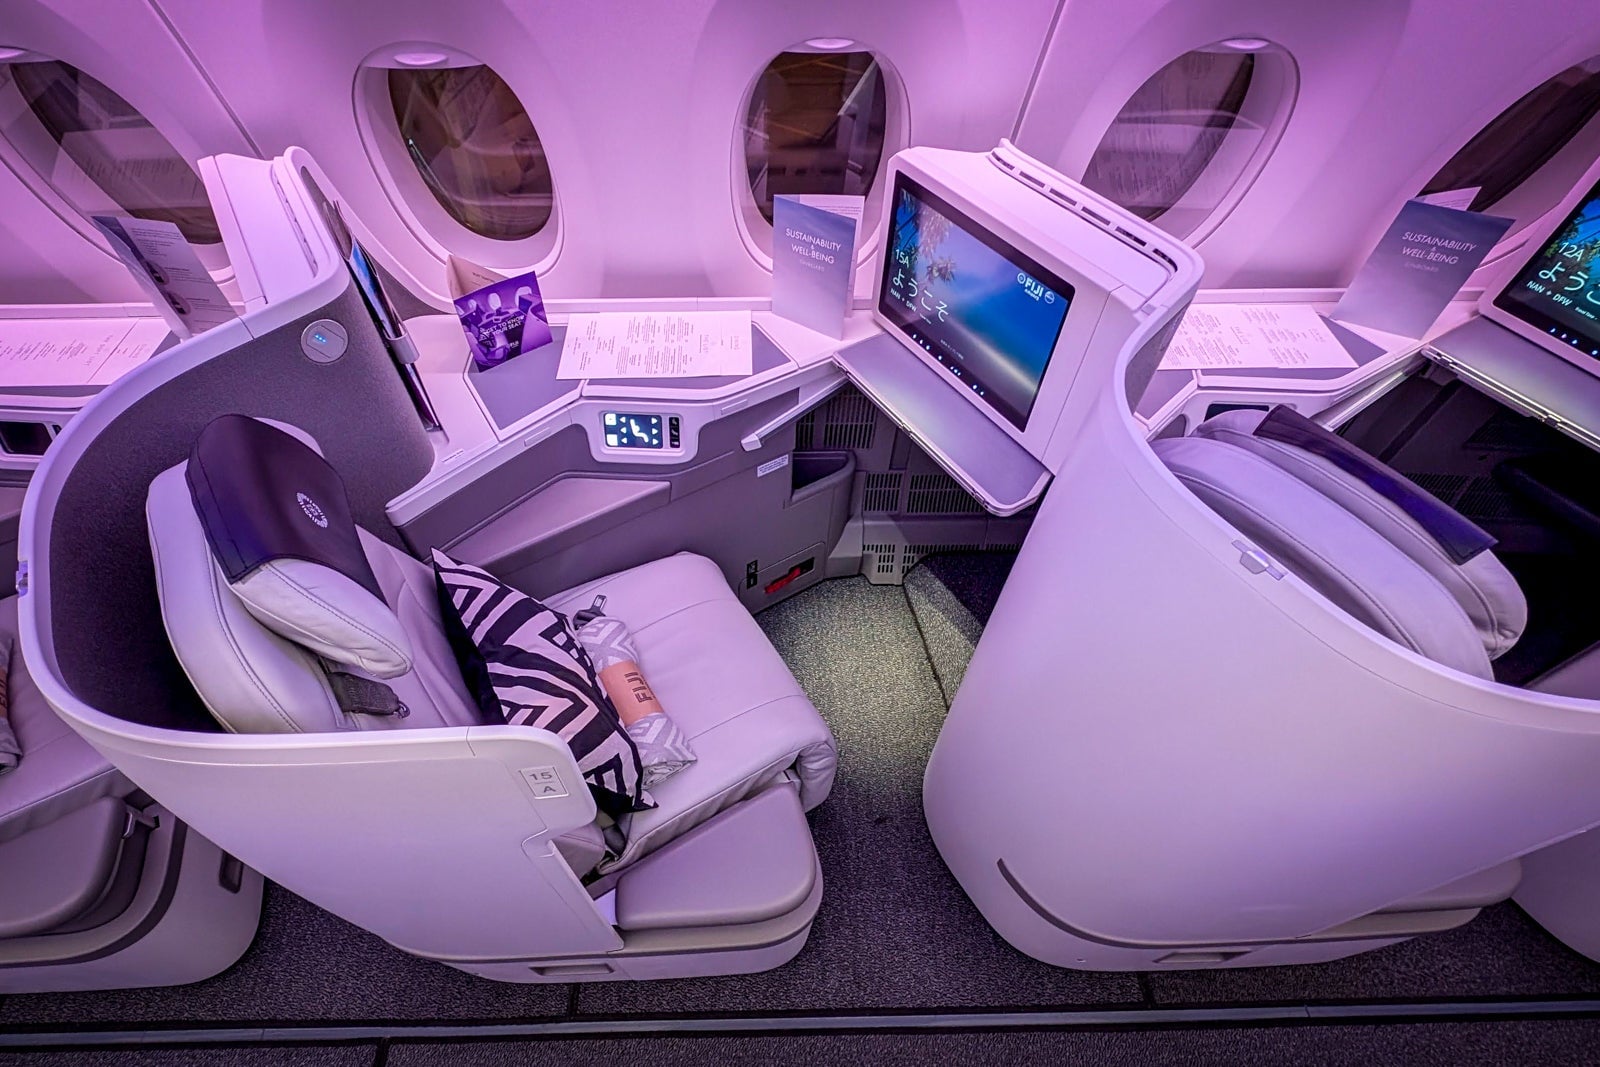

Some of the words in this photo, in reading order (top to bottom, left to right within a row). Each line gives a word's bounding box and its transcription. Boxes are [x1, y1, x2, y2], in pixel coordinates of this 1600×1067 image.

[785, 228, 841, 252] SUSTAINABILITY
[1402, 232, 1477, 252] SUSTAINABILITY
[791, 243, 835, 264] WELL-BEING
[895, 248, 910, 269] 15A
[1402, 246, 1460, 265] WELL-BEING
[1558, 241, 1585, 262] 12A
[892, 268, 949, 323] ようこそ
[1024, 277, 1044, 298] FIJI
[1526, 280, 1546, 294] NAN
[1552, 293, 1573, 307] DFW
[507, 315, 524, 324] KNOW
[508, 322, 521, 330] SEAT
[623, 671, 654, 703] FIJI
[529, 771, 553, 781] 15
[543, 785, 557, 793] A
